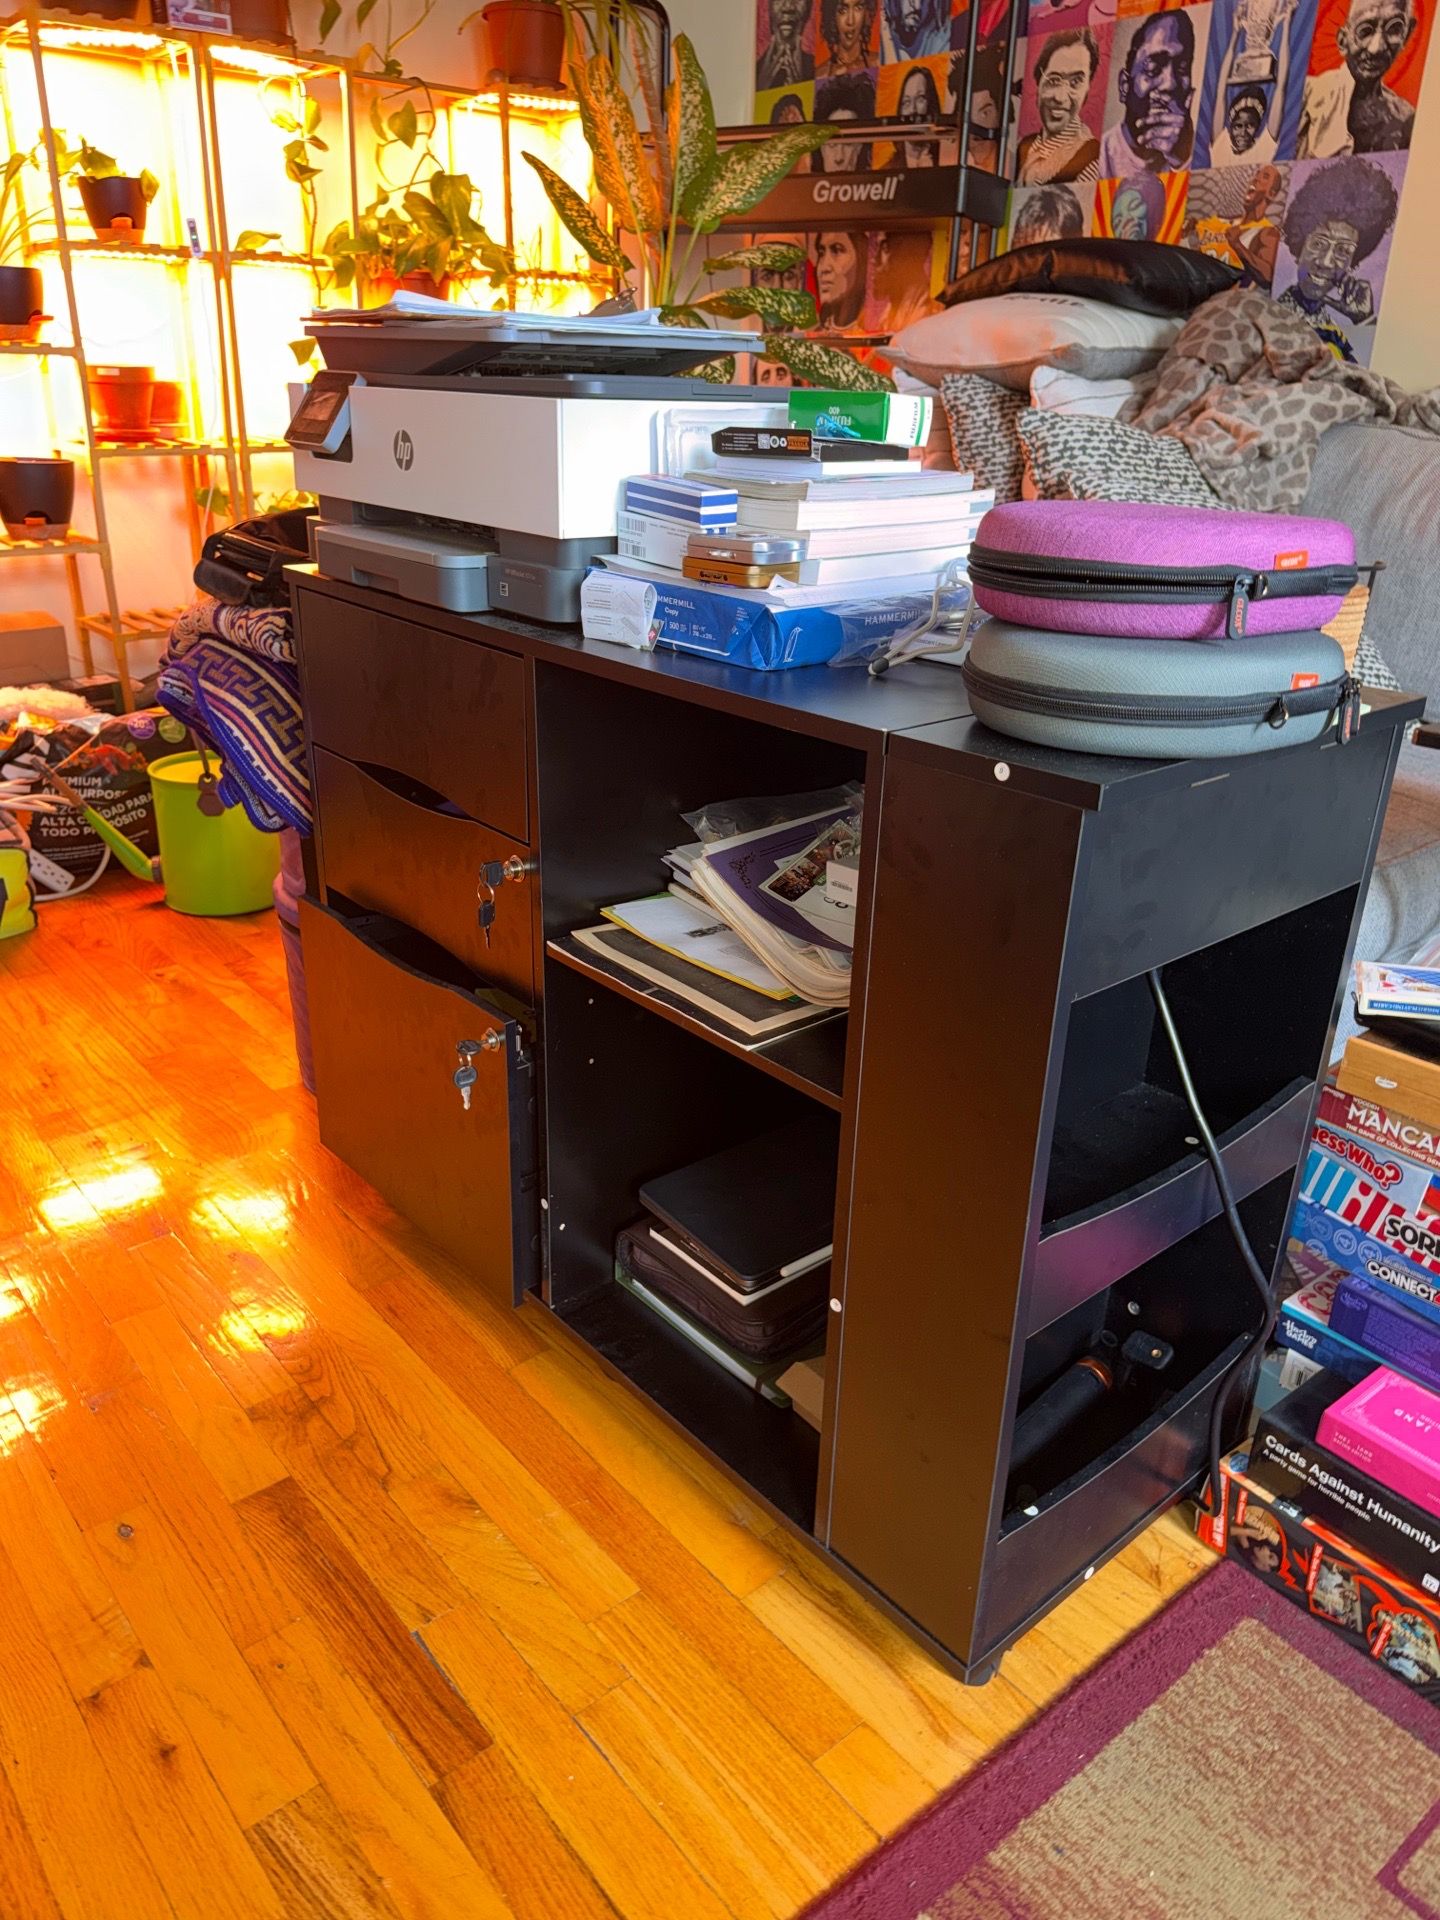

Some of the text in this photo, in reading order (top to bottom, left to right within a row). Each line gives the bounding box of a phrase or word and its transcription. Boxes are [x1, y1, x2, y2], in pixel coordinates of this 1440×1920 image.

[812, 177, 899, 205] Growell
[396, 430, 413, 470] hp
[656, 594, 696, 610] MMERMILL
[664, 606, 679, 617] Copy
[864, 608, 923, 627] HAMMERMI
[42, 776, 102, 787] PMIUM
[40, 816, 75, 827] ALTA
[40, 827, 80, 837] TODO
[1359, 1127, 1376, 1140] GAME
[1347, 1140, 1402, 1190] Who?
[1367, 1260, 1435, 1303] CONNECT
[1282, 1319, 1317, 1343] Hasbro
[1262, 1448, 1372, 1523] A party game for horrible people.
[1265, 1435, 1440, 1554] Cards Against Humanity
